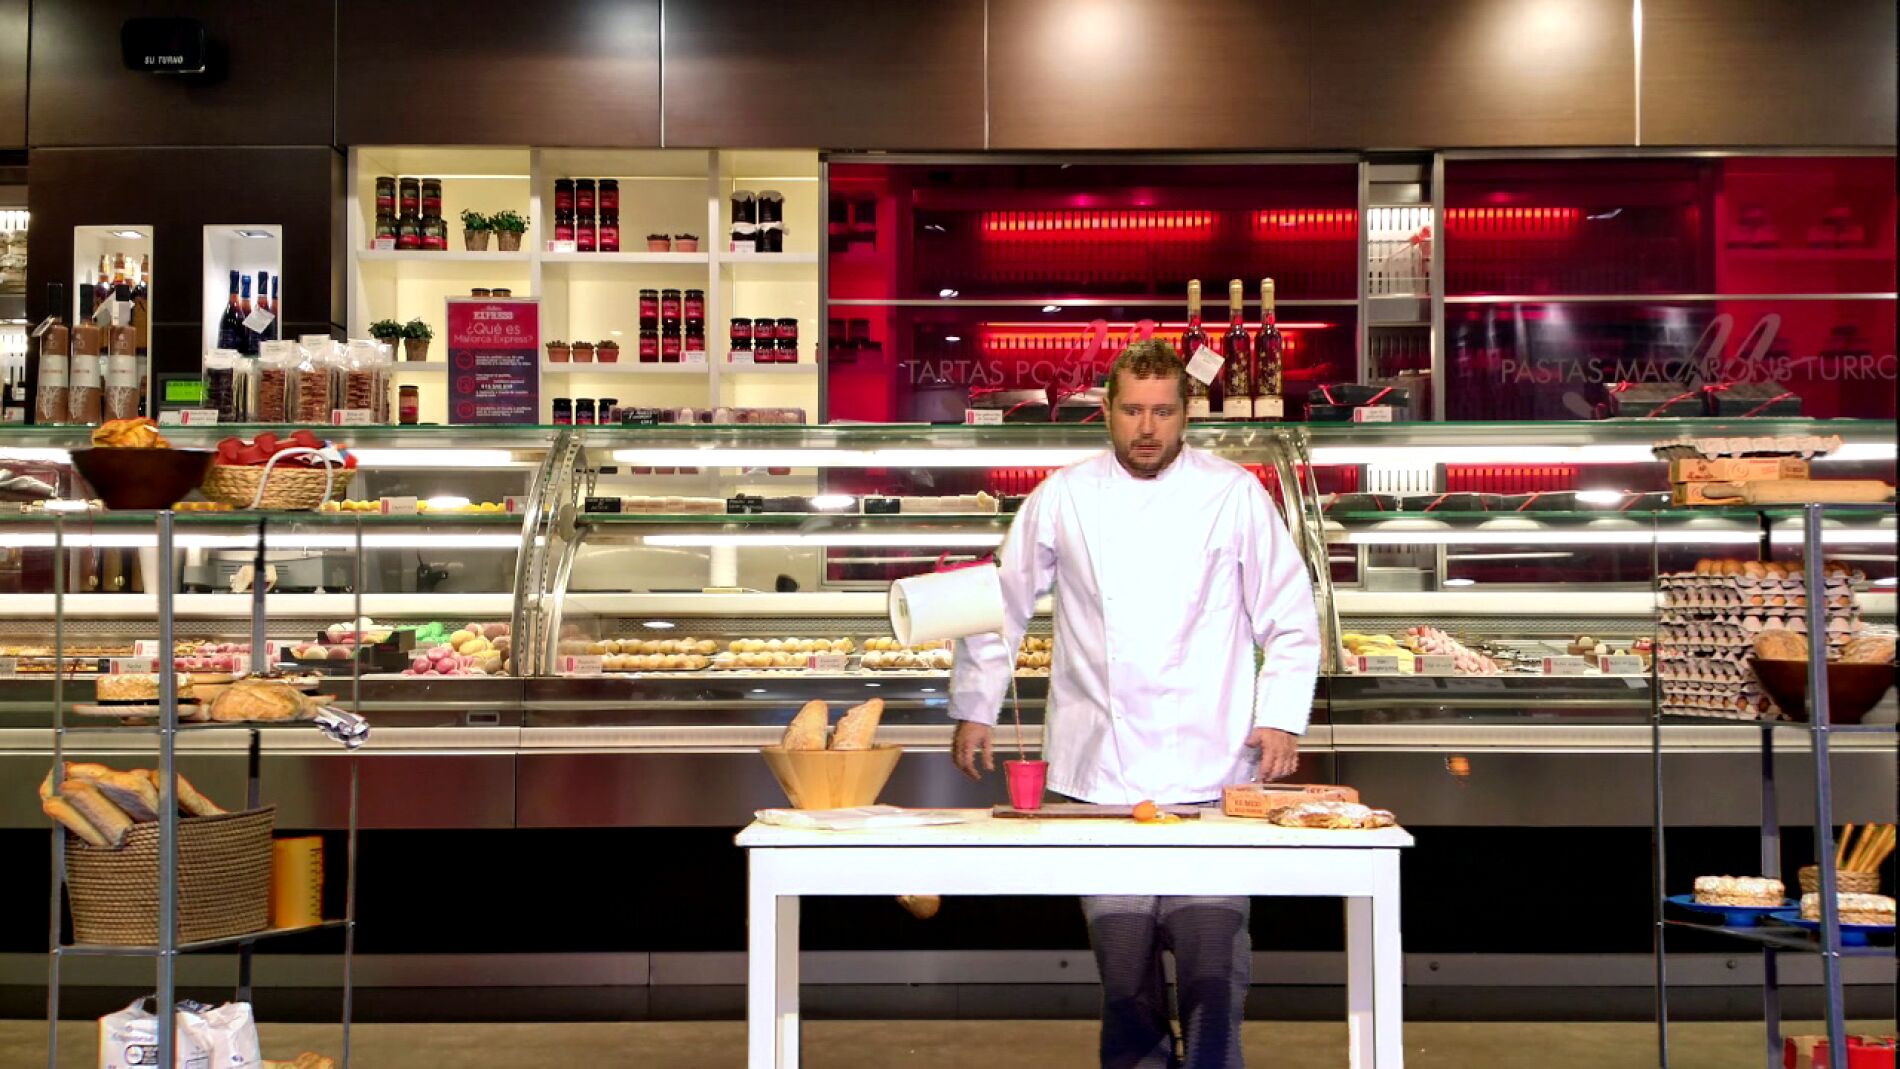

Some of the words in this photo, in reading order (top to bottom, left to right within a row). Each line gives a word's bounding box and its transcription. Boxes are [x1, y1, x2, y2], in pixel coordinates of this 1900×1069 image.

[158, 55, 184, 65] TURNO
[473, 311, 514, 320] EXPRESS
[466, 321, 503, 335] ¿Qué
[505, 325, 521, 335] es
[903, 359, 1005, 384] TARTAS
[1501, 357, 1604, 384] PASTAS
[1614, 355, 1792, 383] MACARONS
